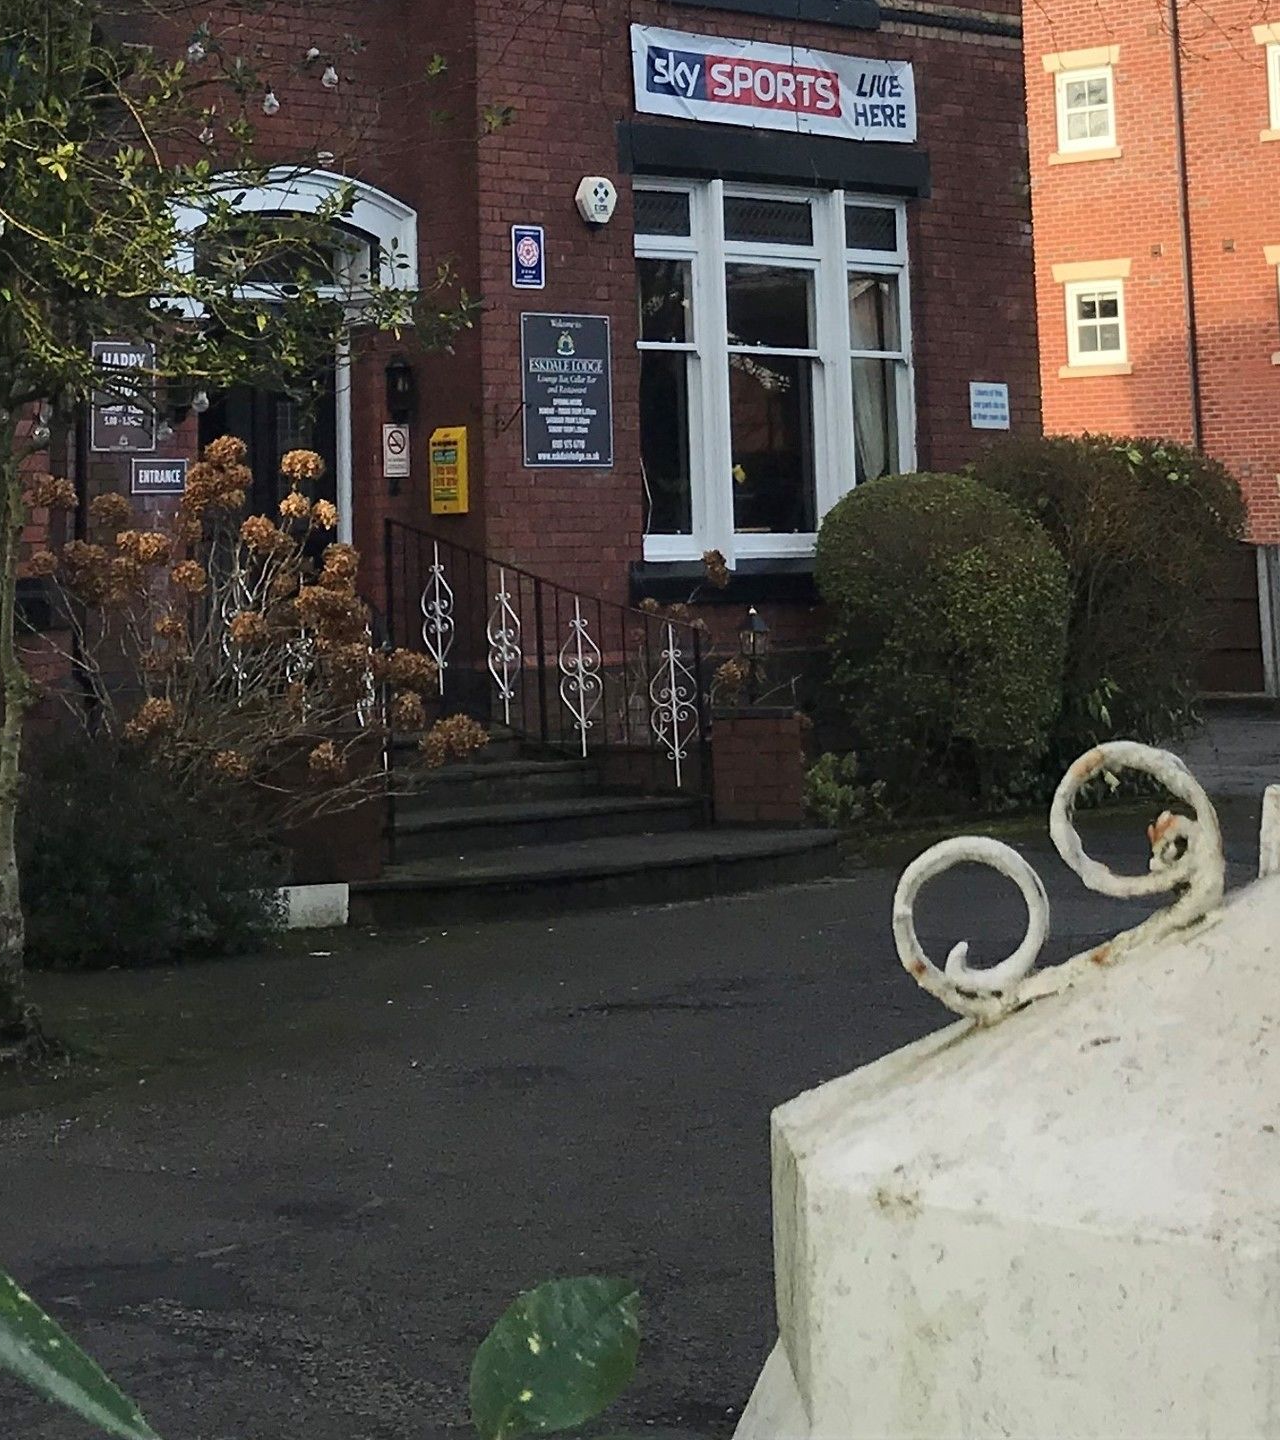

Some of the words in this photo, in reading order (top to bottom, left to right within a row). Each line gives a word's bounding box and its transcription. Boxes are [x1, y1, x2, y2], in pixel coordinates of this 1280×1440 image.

[653, 52, 700, 97] sky
[711, 64, 836, 110] SPORTS
[856, 73, 902, 98] LIVE
[853, 102, 907, 128] HERE
[529, 358, 571, 373] ESKDALE
[572, 359, 603, 374] LODGE
[138, 469, 181, 484] ENTRANCE
